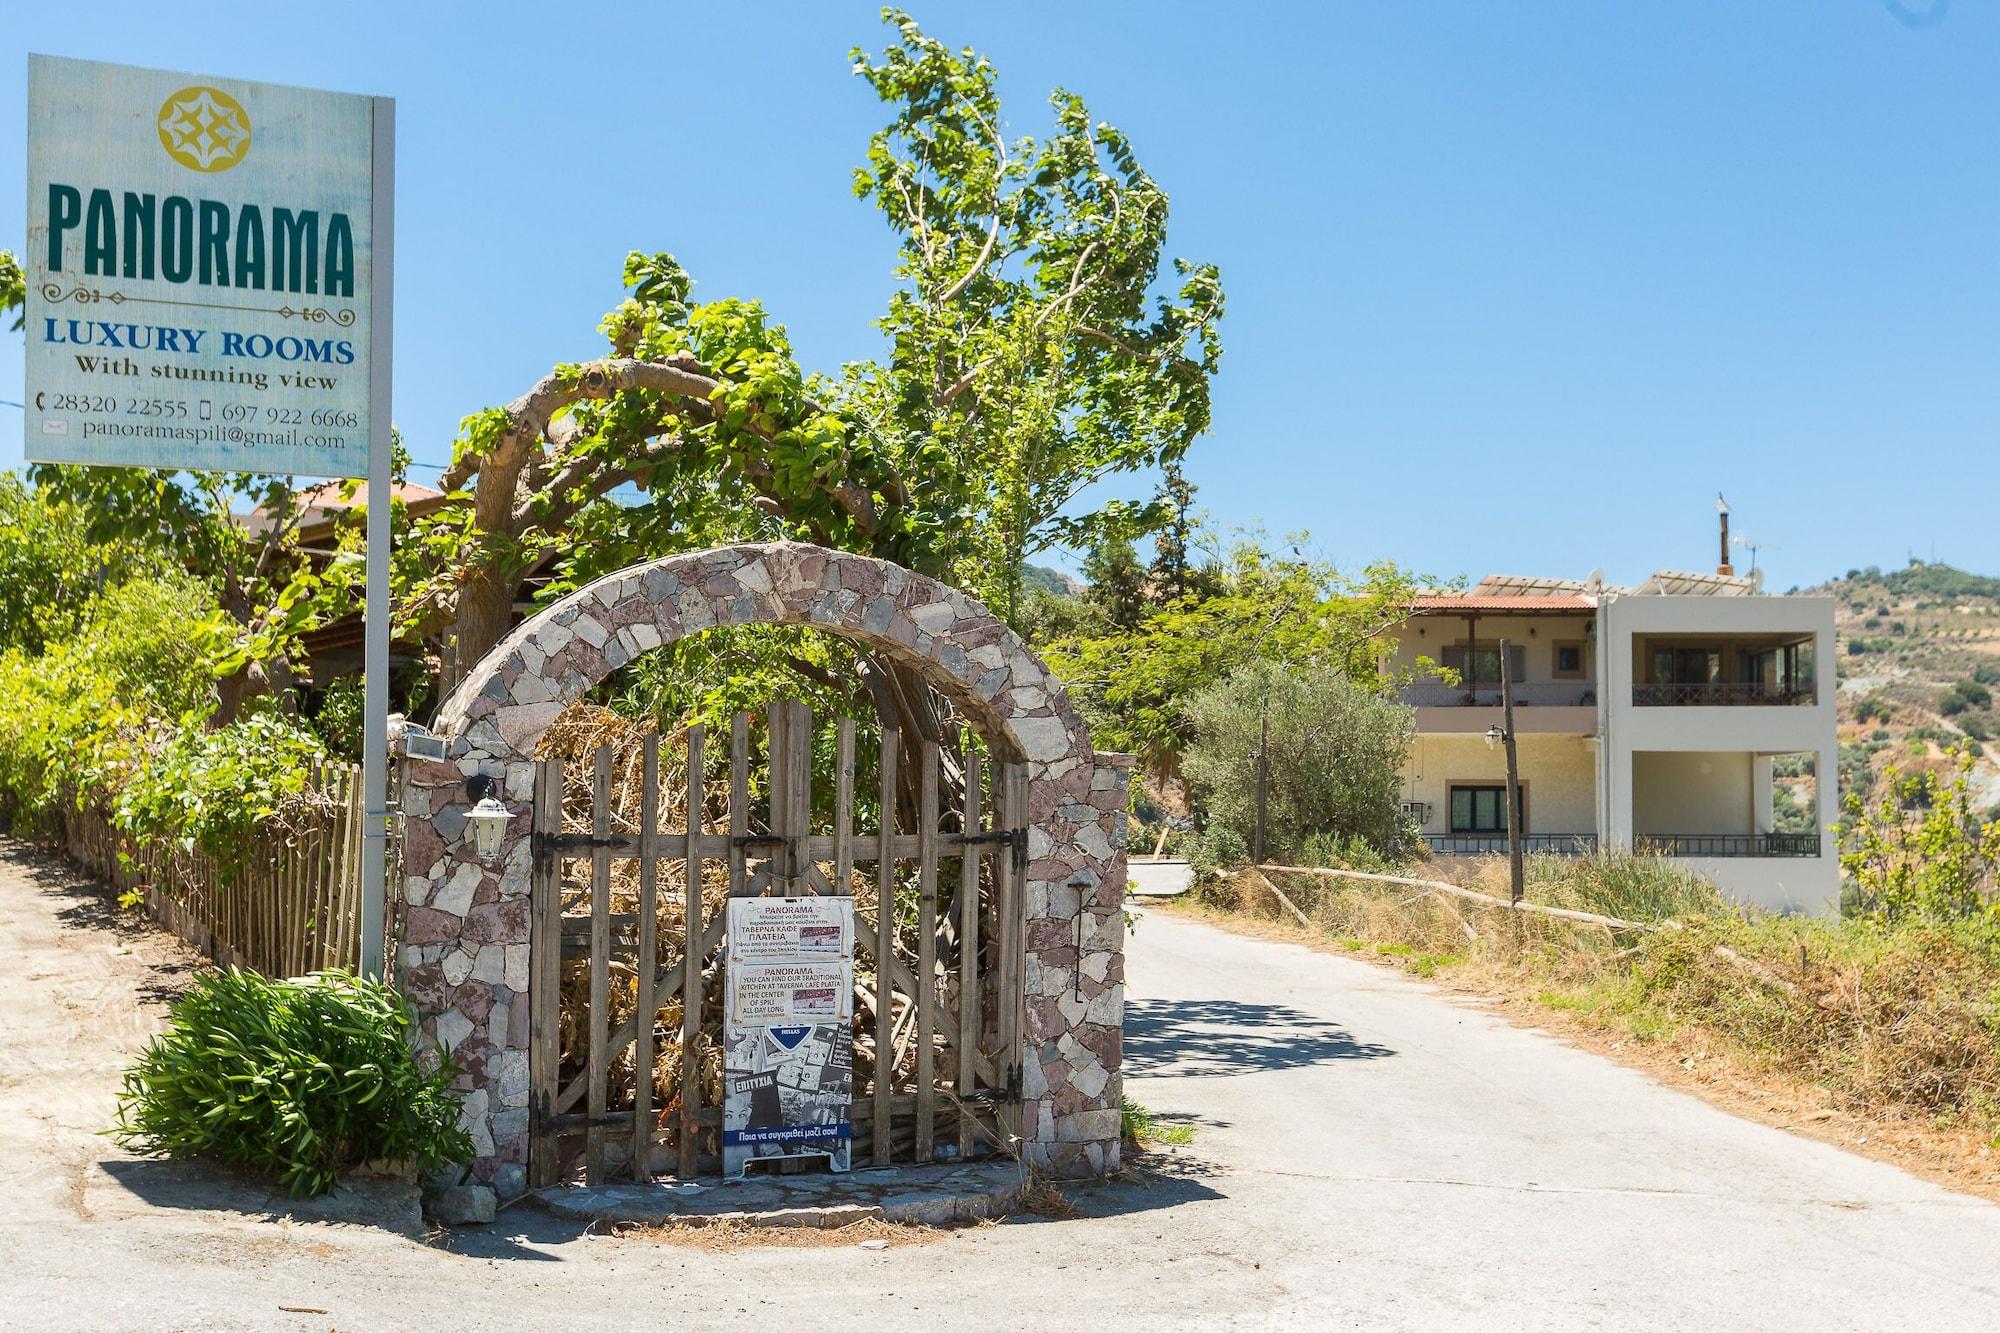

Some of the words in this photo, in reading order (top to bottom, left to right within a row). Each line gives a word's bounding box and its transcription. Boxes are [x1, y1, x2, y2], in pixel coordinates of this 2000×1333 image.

[49, 183, 355, 298] PANORAMA
[44, 317, 207, 354] LUXURY
[221, 332, 355, 365] ROOMS
[74, 355, 140, 377] With
[151, 362, 269, 391] stunning
[279, 371, 339, 391] view
[53, 393, 117, 414] 28320
[126, 398, 188, 419] 22555
[222, 403, 259, 425] 697
[267, 407, 302, 425] 922
[311, 408, 358, 429] 6668
[83, 421, 346, 450] panoramaspili@gmail.com
[765, 906, 813, 914] PANORAMA
[742, 926, 775, 934] ΤΑΒΕΡΝΑ
[776, 925, 798, 933] ΚΑΦΕ
[749, 933, 786, 941] ΠΛΑΤΕΙΑ
[765, 967, 813, 976] PANORAMA
[735, 1075, 773, 1091] ΕΠΙΤΥΧΙΑ
[738, 1131, 756, 1141] Ποια
[757, 1132, 767, 1140] να
[768, 1128, 804, 1141] συγκριθεί
[804, 1126, 822, 1138] μαζί
[822, 1126, 838, 1136] σου!
